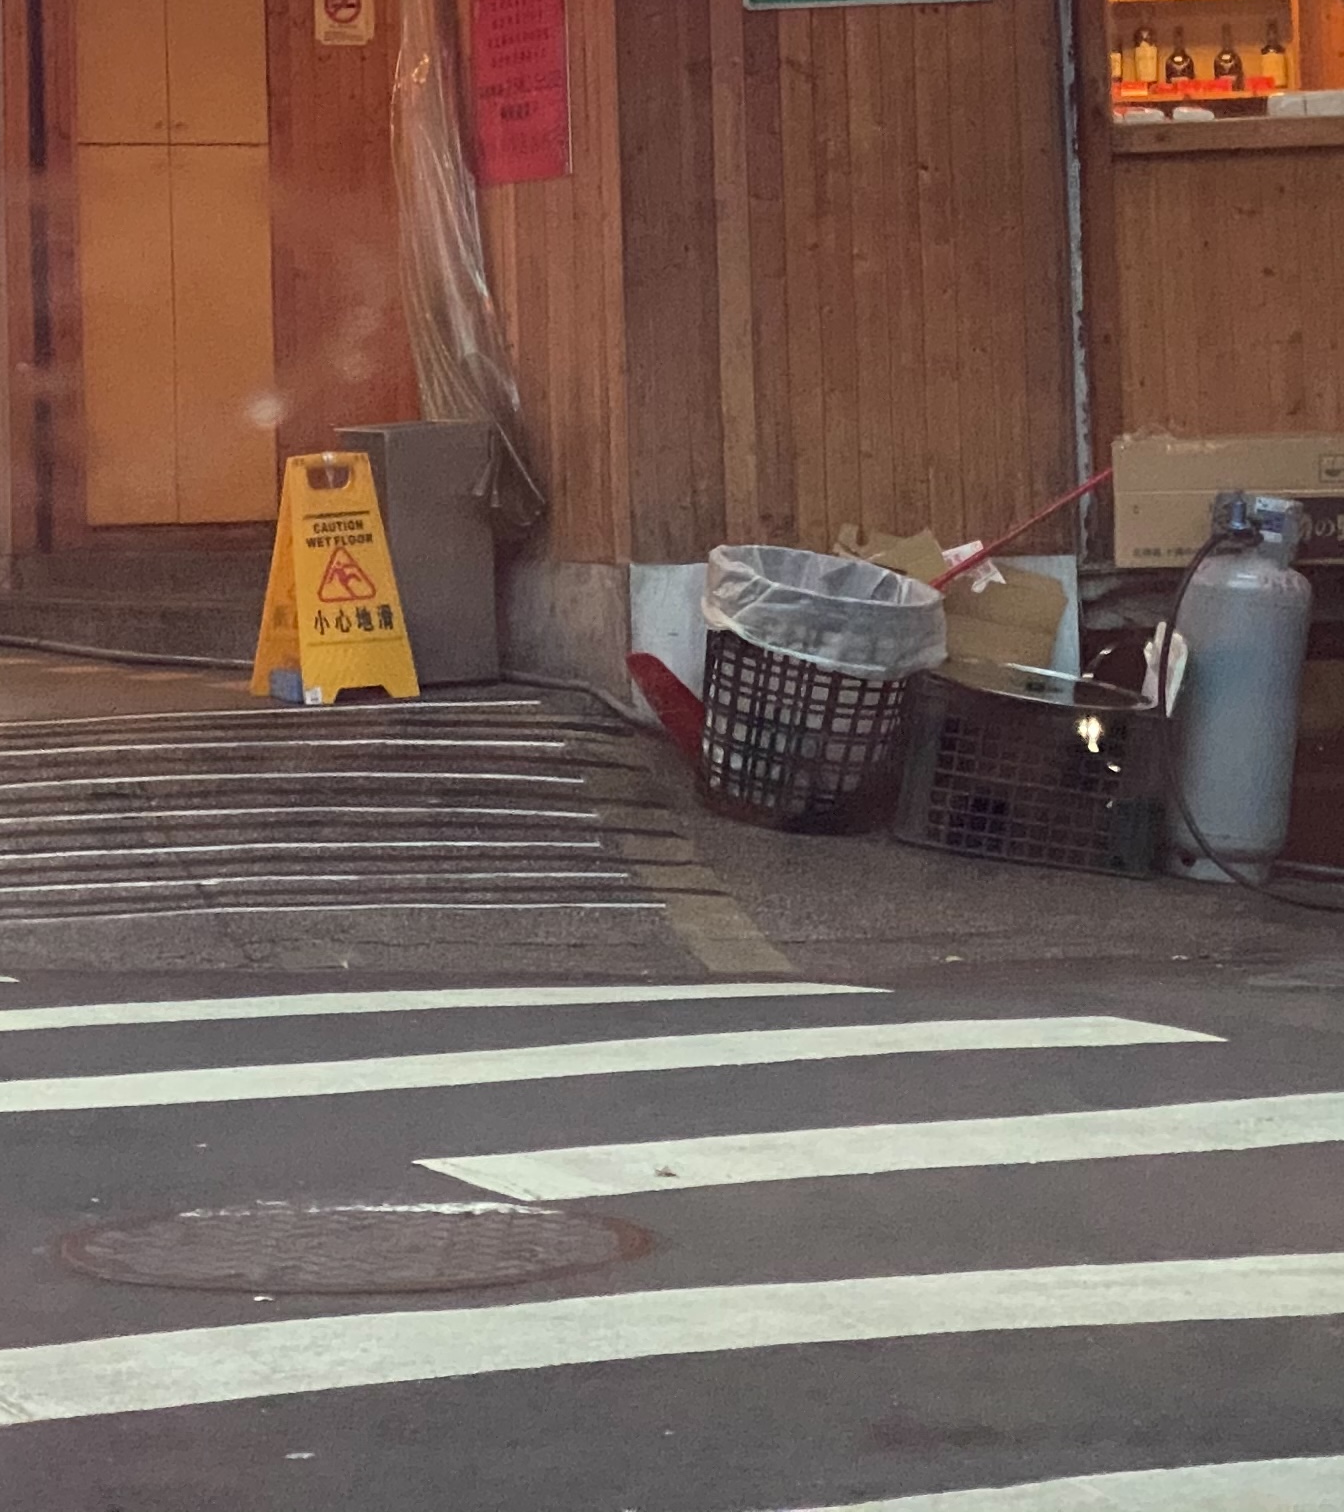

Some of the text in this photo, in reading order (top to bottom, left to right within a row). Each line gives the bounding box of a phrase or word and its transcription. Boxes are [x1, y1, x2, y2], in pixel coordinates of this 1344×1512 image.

[312, 518, 364, 535] CAUTION
[306, 533, 374, 548] WET FLOOR
[313, 603, 395, 635] 小心地滑
